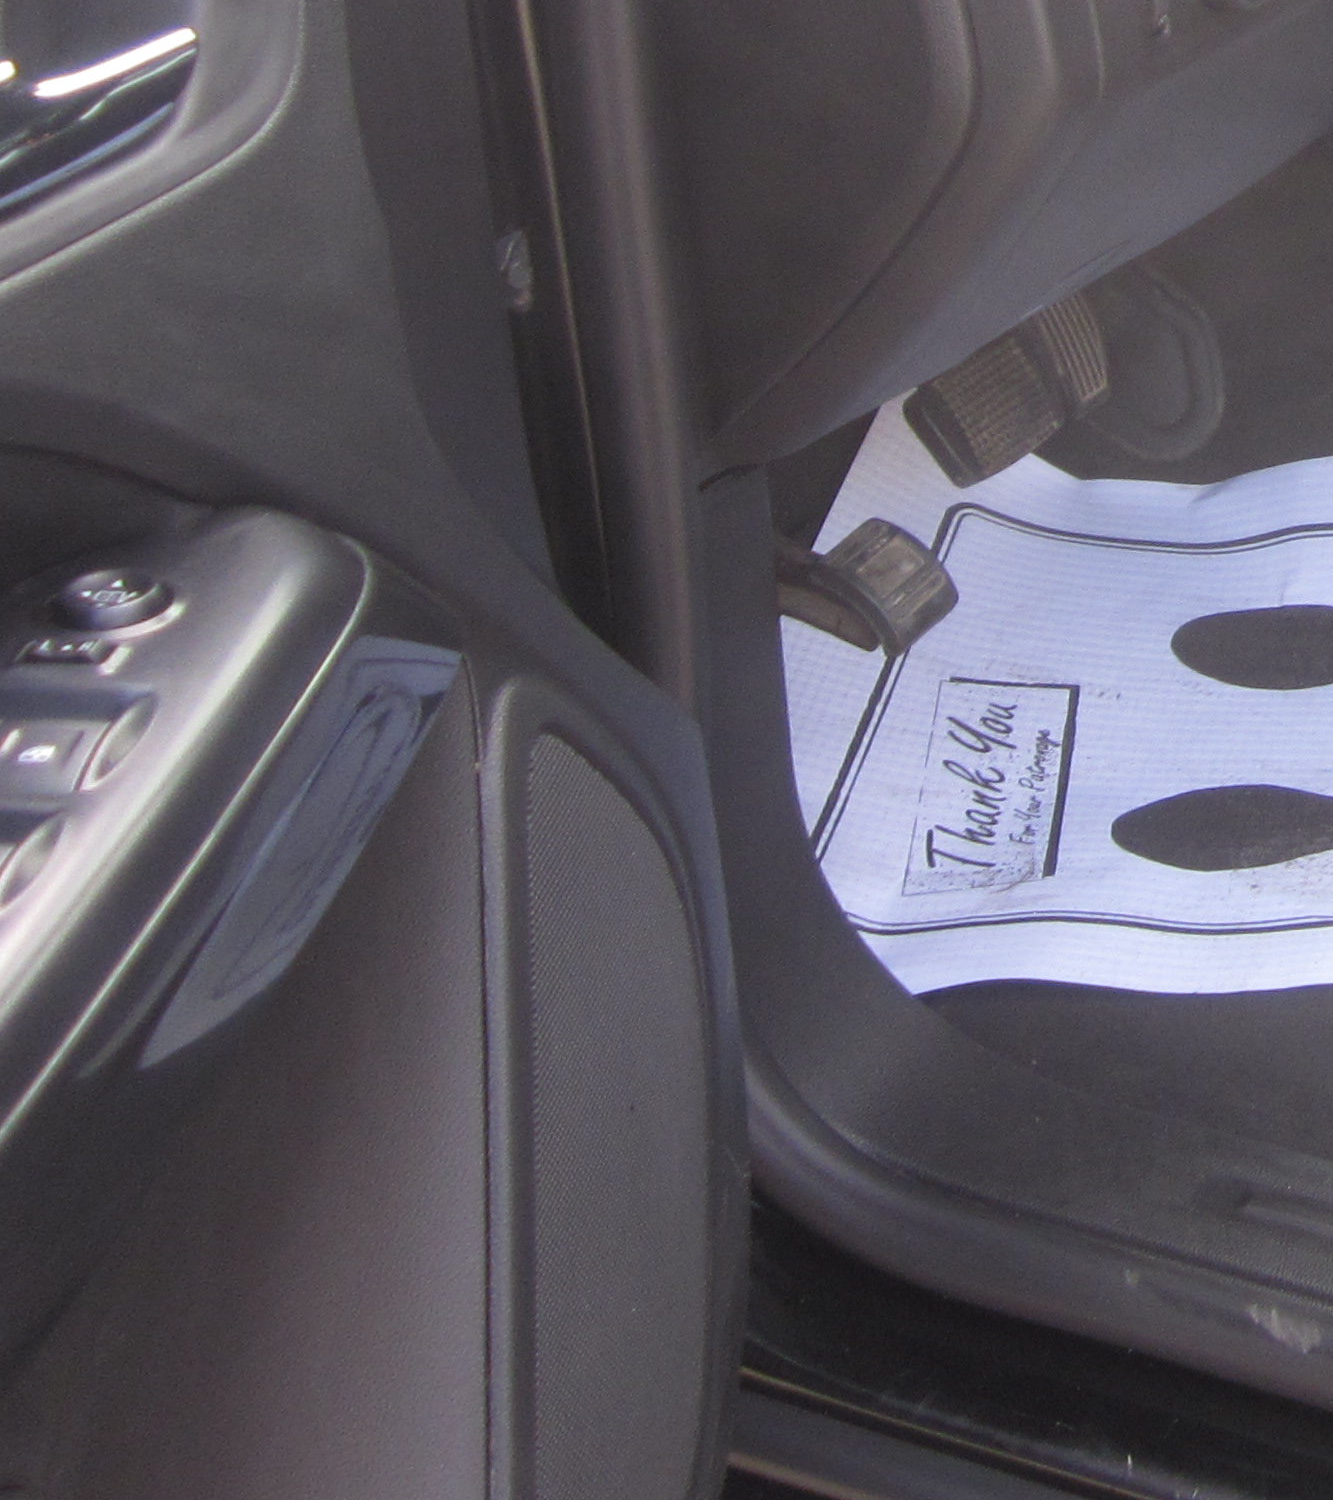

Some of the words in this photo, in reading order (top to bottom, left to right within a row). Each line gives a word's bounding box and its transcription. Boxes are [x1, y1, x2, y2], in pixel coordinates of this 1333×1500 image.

[946, 702, 1018, 754] You
[926, 759, 1007, 868] Thank
[1008, 823, 1040, 845] For
